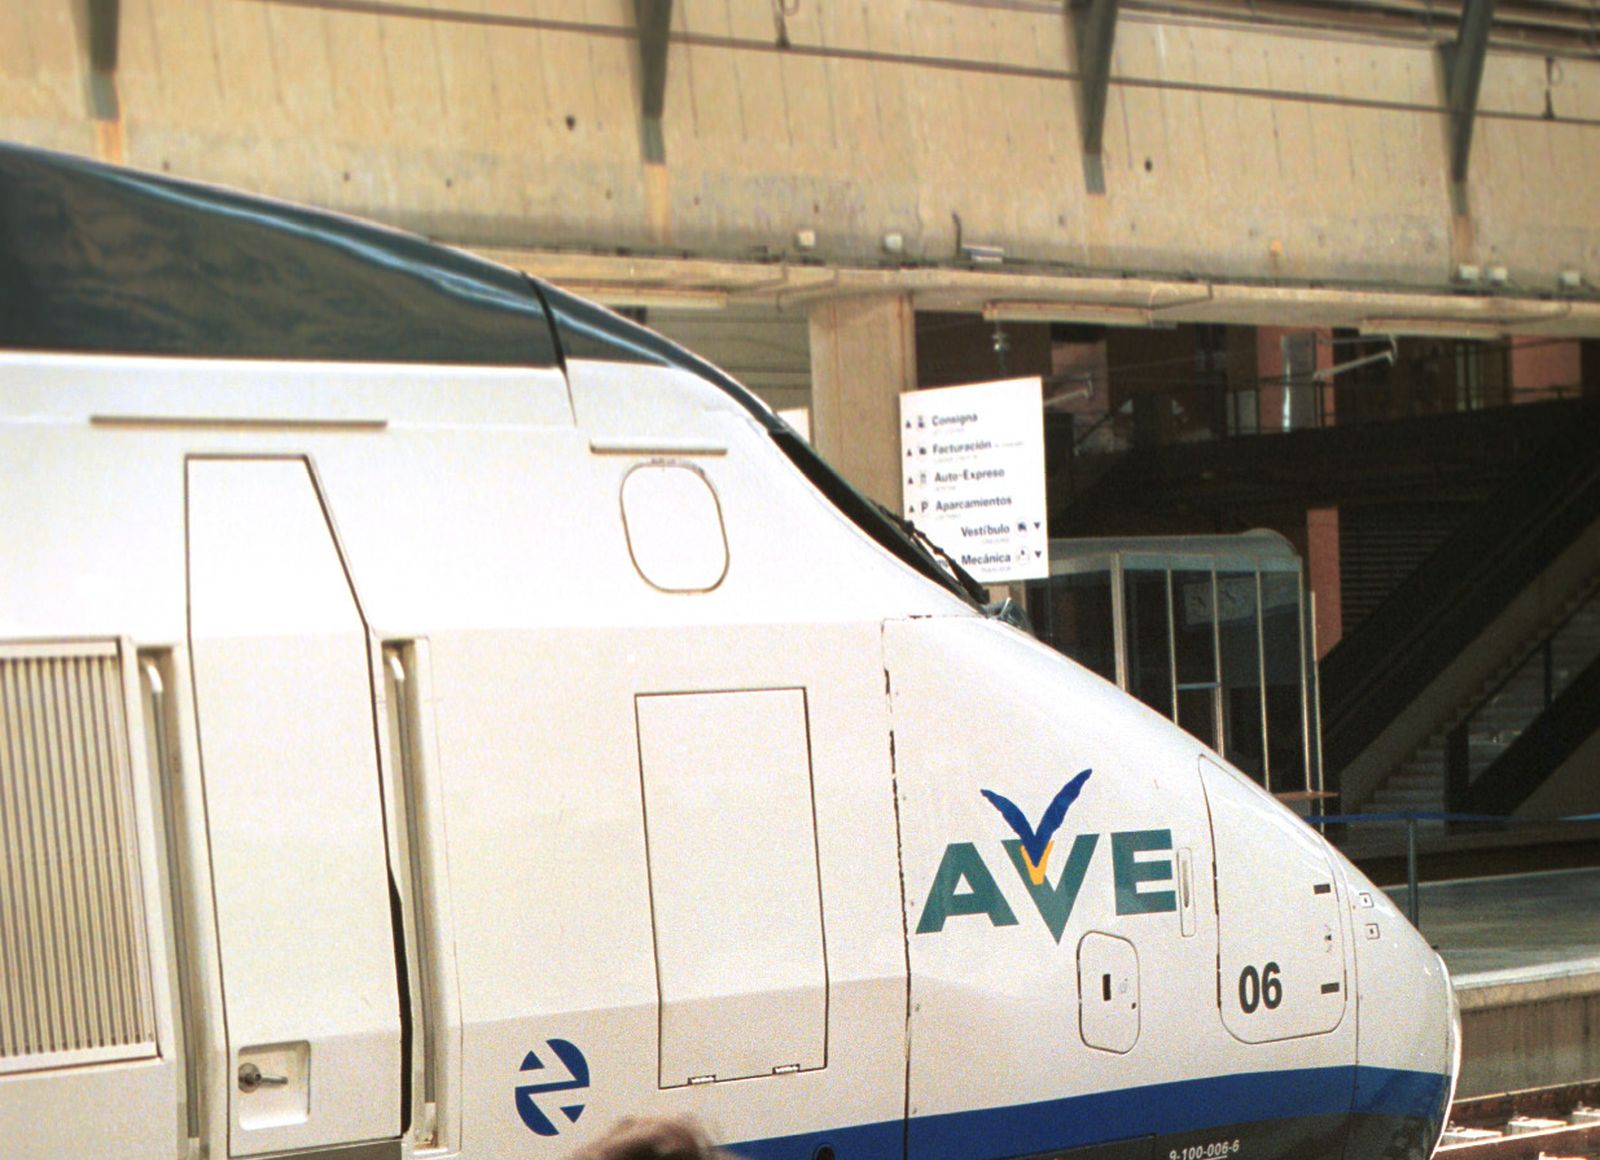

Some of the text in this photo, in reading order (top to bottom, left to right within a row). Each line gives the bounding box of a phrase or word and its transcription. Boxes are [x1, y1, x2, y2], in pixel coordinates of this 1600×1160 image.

[932, 413, 978, 427] Consigna
[932, 440, 992, 455] Facturación
[934, 468, 1005, 482] Auto-Expreso
[936, 496, 1012, 512] Aparcamientos
[961, 523, 1010, 537] Vestíbulo
[961, 552, 1011, 565] Mecánica
[915, 829, 1177, 945] AVE
[1238, 962, 1282, 1014] 06
